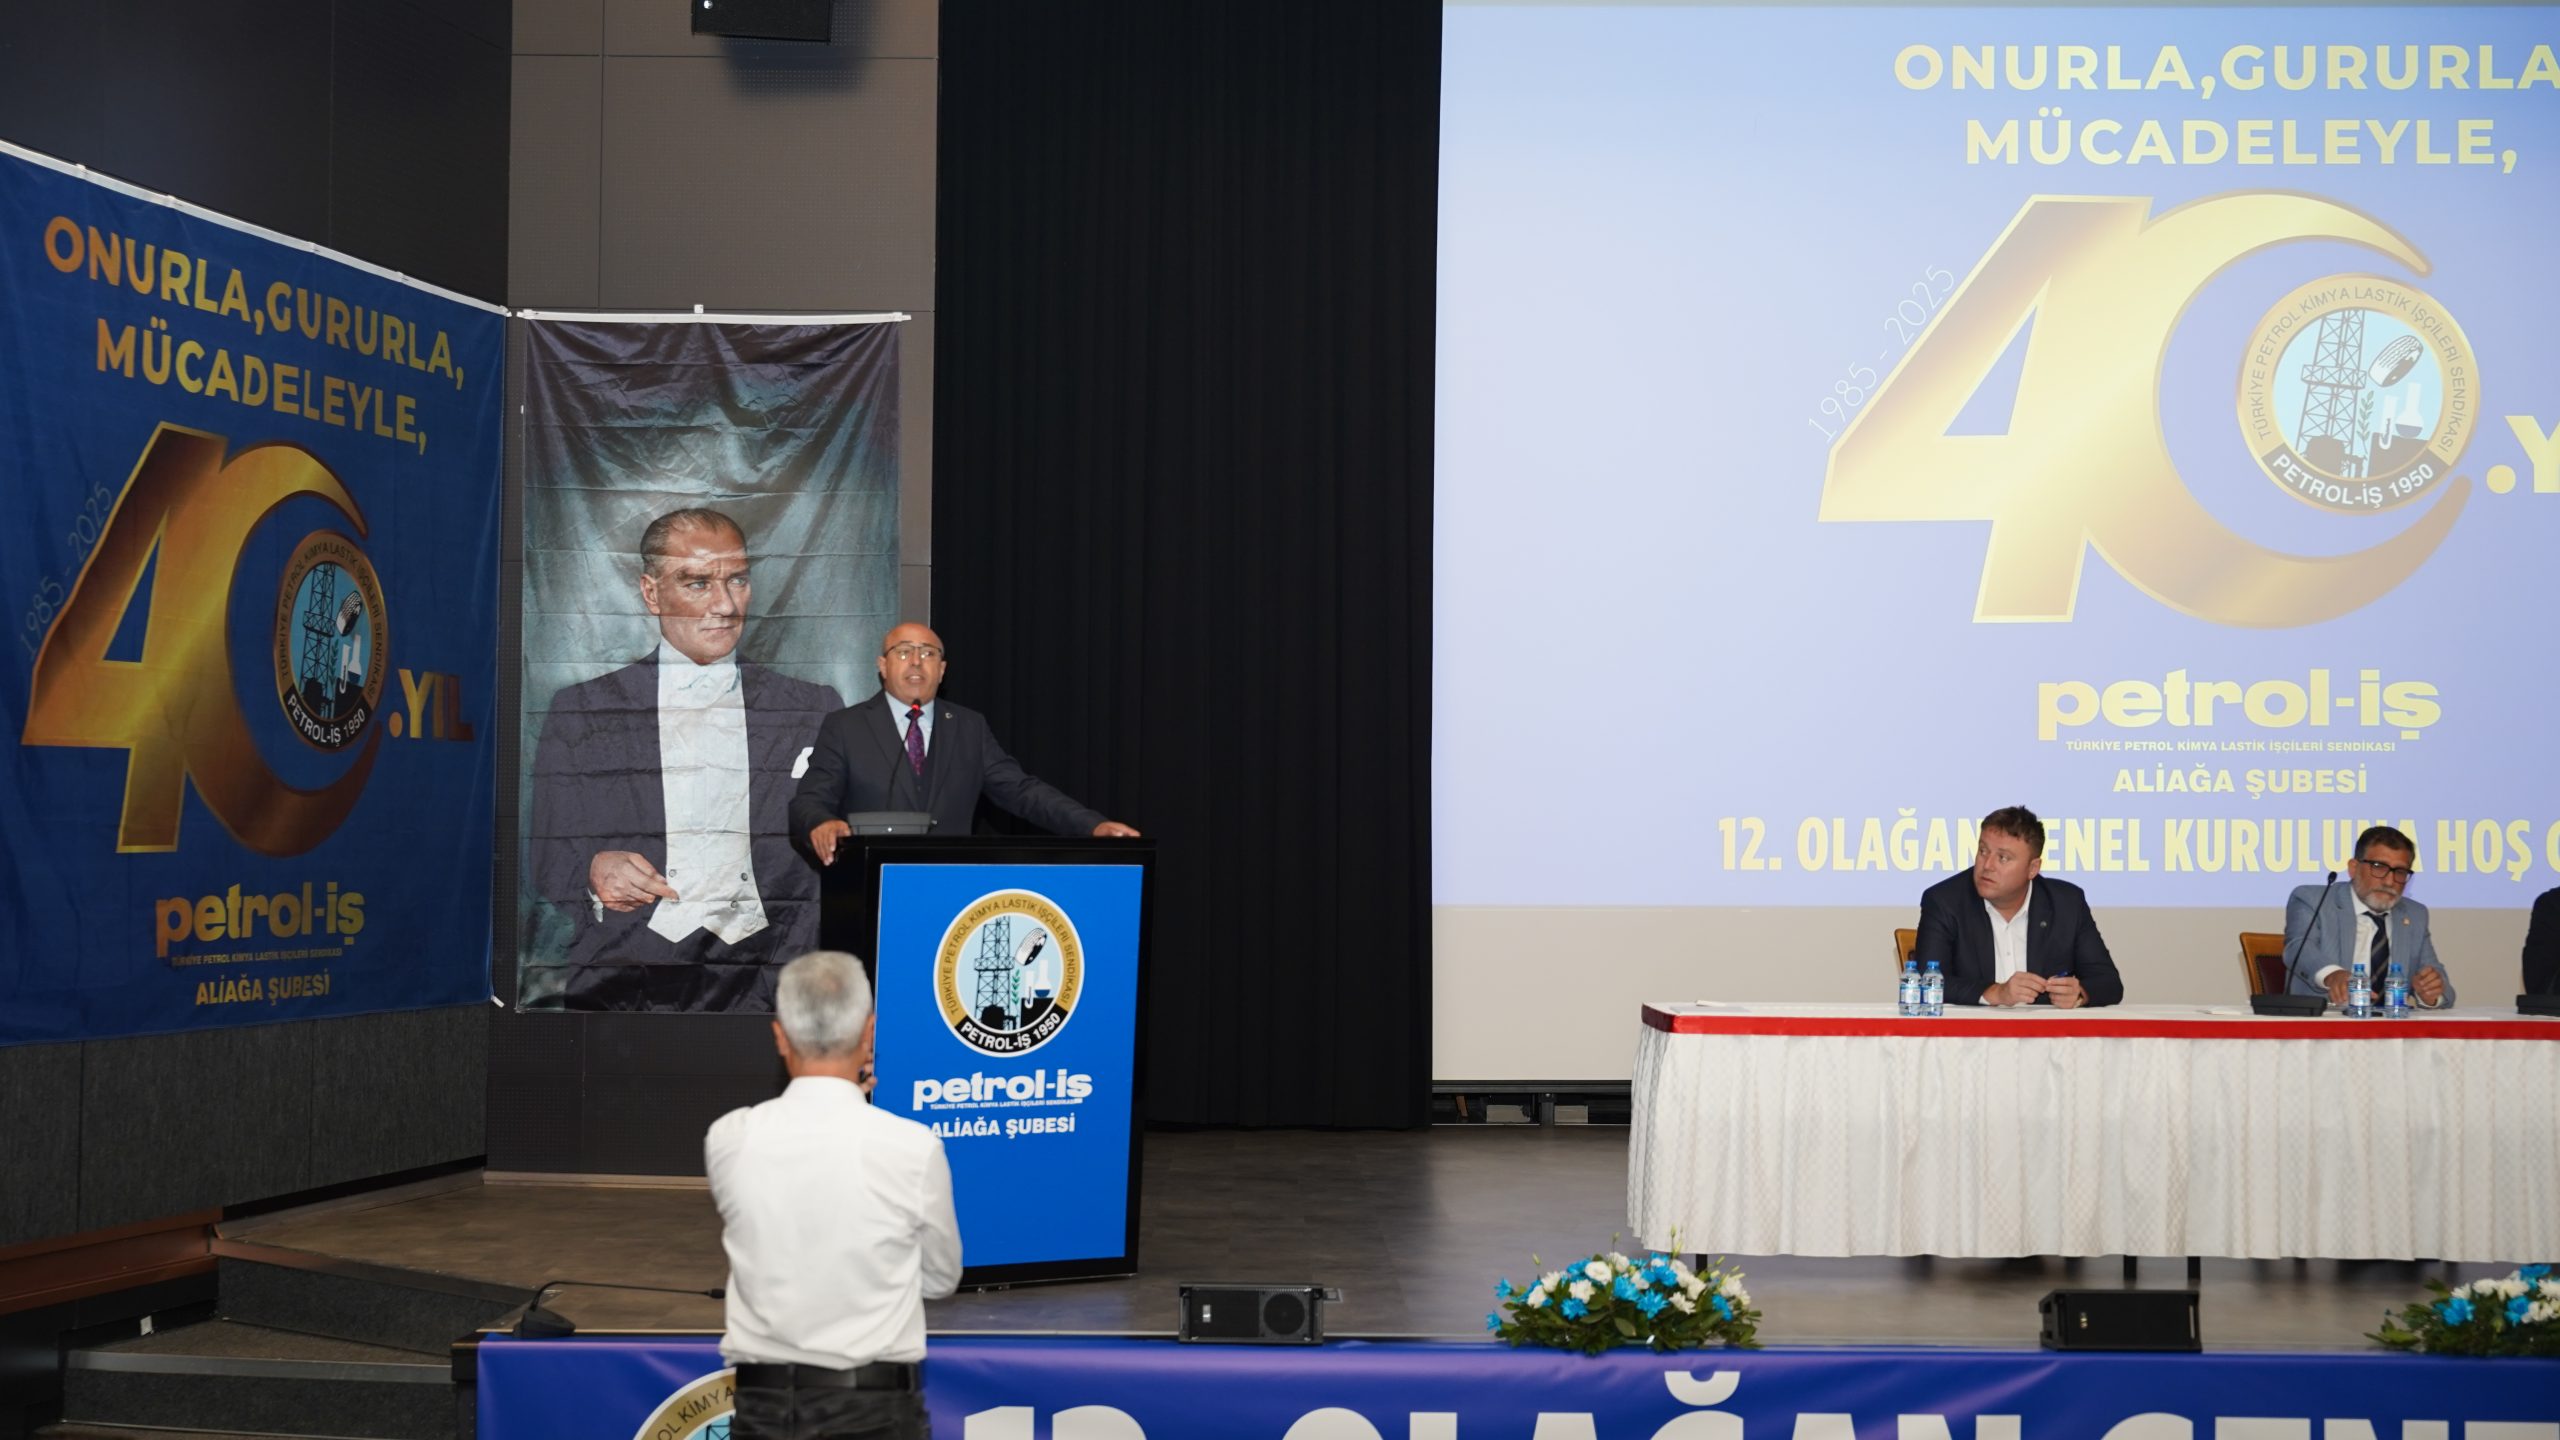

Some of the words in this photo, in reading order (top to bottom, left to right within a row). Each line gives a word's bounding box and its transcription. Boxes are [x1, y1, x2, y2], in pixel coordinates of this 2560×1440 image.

[1966, 106, 2517, 174] MÜCADELEYLE,
[2299, 287, 2350, 312] KİMYA
[2354, 286, 2413, 311] LASTİK
[1808, 361, 1877, 443] 1985
[1884, 265, 1954, 345] 2025
[2256, 311, 2300, 366] PETROL
[2410, 300, 2462, 363] İŞÇİLERİ
[96, 316, 427, 455] MÜCADELEYLE,
[2247, 368, 2272, 441] TÜRKİYE
[2438, 366, 2467, 453] SENDİKASI
[2272, 454, 2383, 508] PETROL-İŞ
[2388, 463, 2434, 497] 1950
[20, 576, 64, 660] 1985
[68, 481, 112, 563] 2025
[287, 694, 341, 747] PETROL-İŞ
[343, 708, 366, 738] 1950
[388, 668, 475, 742] .YIL
[2038, 668, 2441, 740] petrol-iş
[2065, 738, 2121, 752] TÜRKİYE
[2124, 740, 2173, 752] PETROL
[2177, 738, 2217, 752] KİMYA
[2221, 738, 2265, 752] LASTİK
[2269, 738, 2323, 753] İŞÇİLERİ
[2327, 738, 2396, 752] SENDİKASI
[2113, 762, 2235, 792] ALİAĞA
[2246, 763, 2366, 799] ŞUBESİ
[1718, 816, 1782, 870] 12.
[1798, 808, 1983, 871] OLAĞAN
[2038, 818, 2150, 871] ENEL
[2437, 819, 2532, 882] HOŞ
[155, 881, 365, 958] petrol-iş
[945, 921, 970, 964] PETROL
[970, 901, 1000, 923] KİMYA
[1002, 898, 1037, 911] LASTİK
[1061, 944, 1077, 1004] SENDİKASI
[196, 973, 263, 1005] ALİAĞA
[268, 968, 330, 1006] ŞUBESİ
[960, 1022, 1031, 1049] PETROL-İŞ
[1032, 1012, 1061, 1039] 1950
[912, 1068, 1093, 1111] petrol-iş
[931, 1116, 1000, 1138] ALİAĞA
[1005, 1112, 1075, 1139] ŞUBESİ
[677, 1386, 735, 1423] KİMYA
